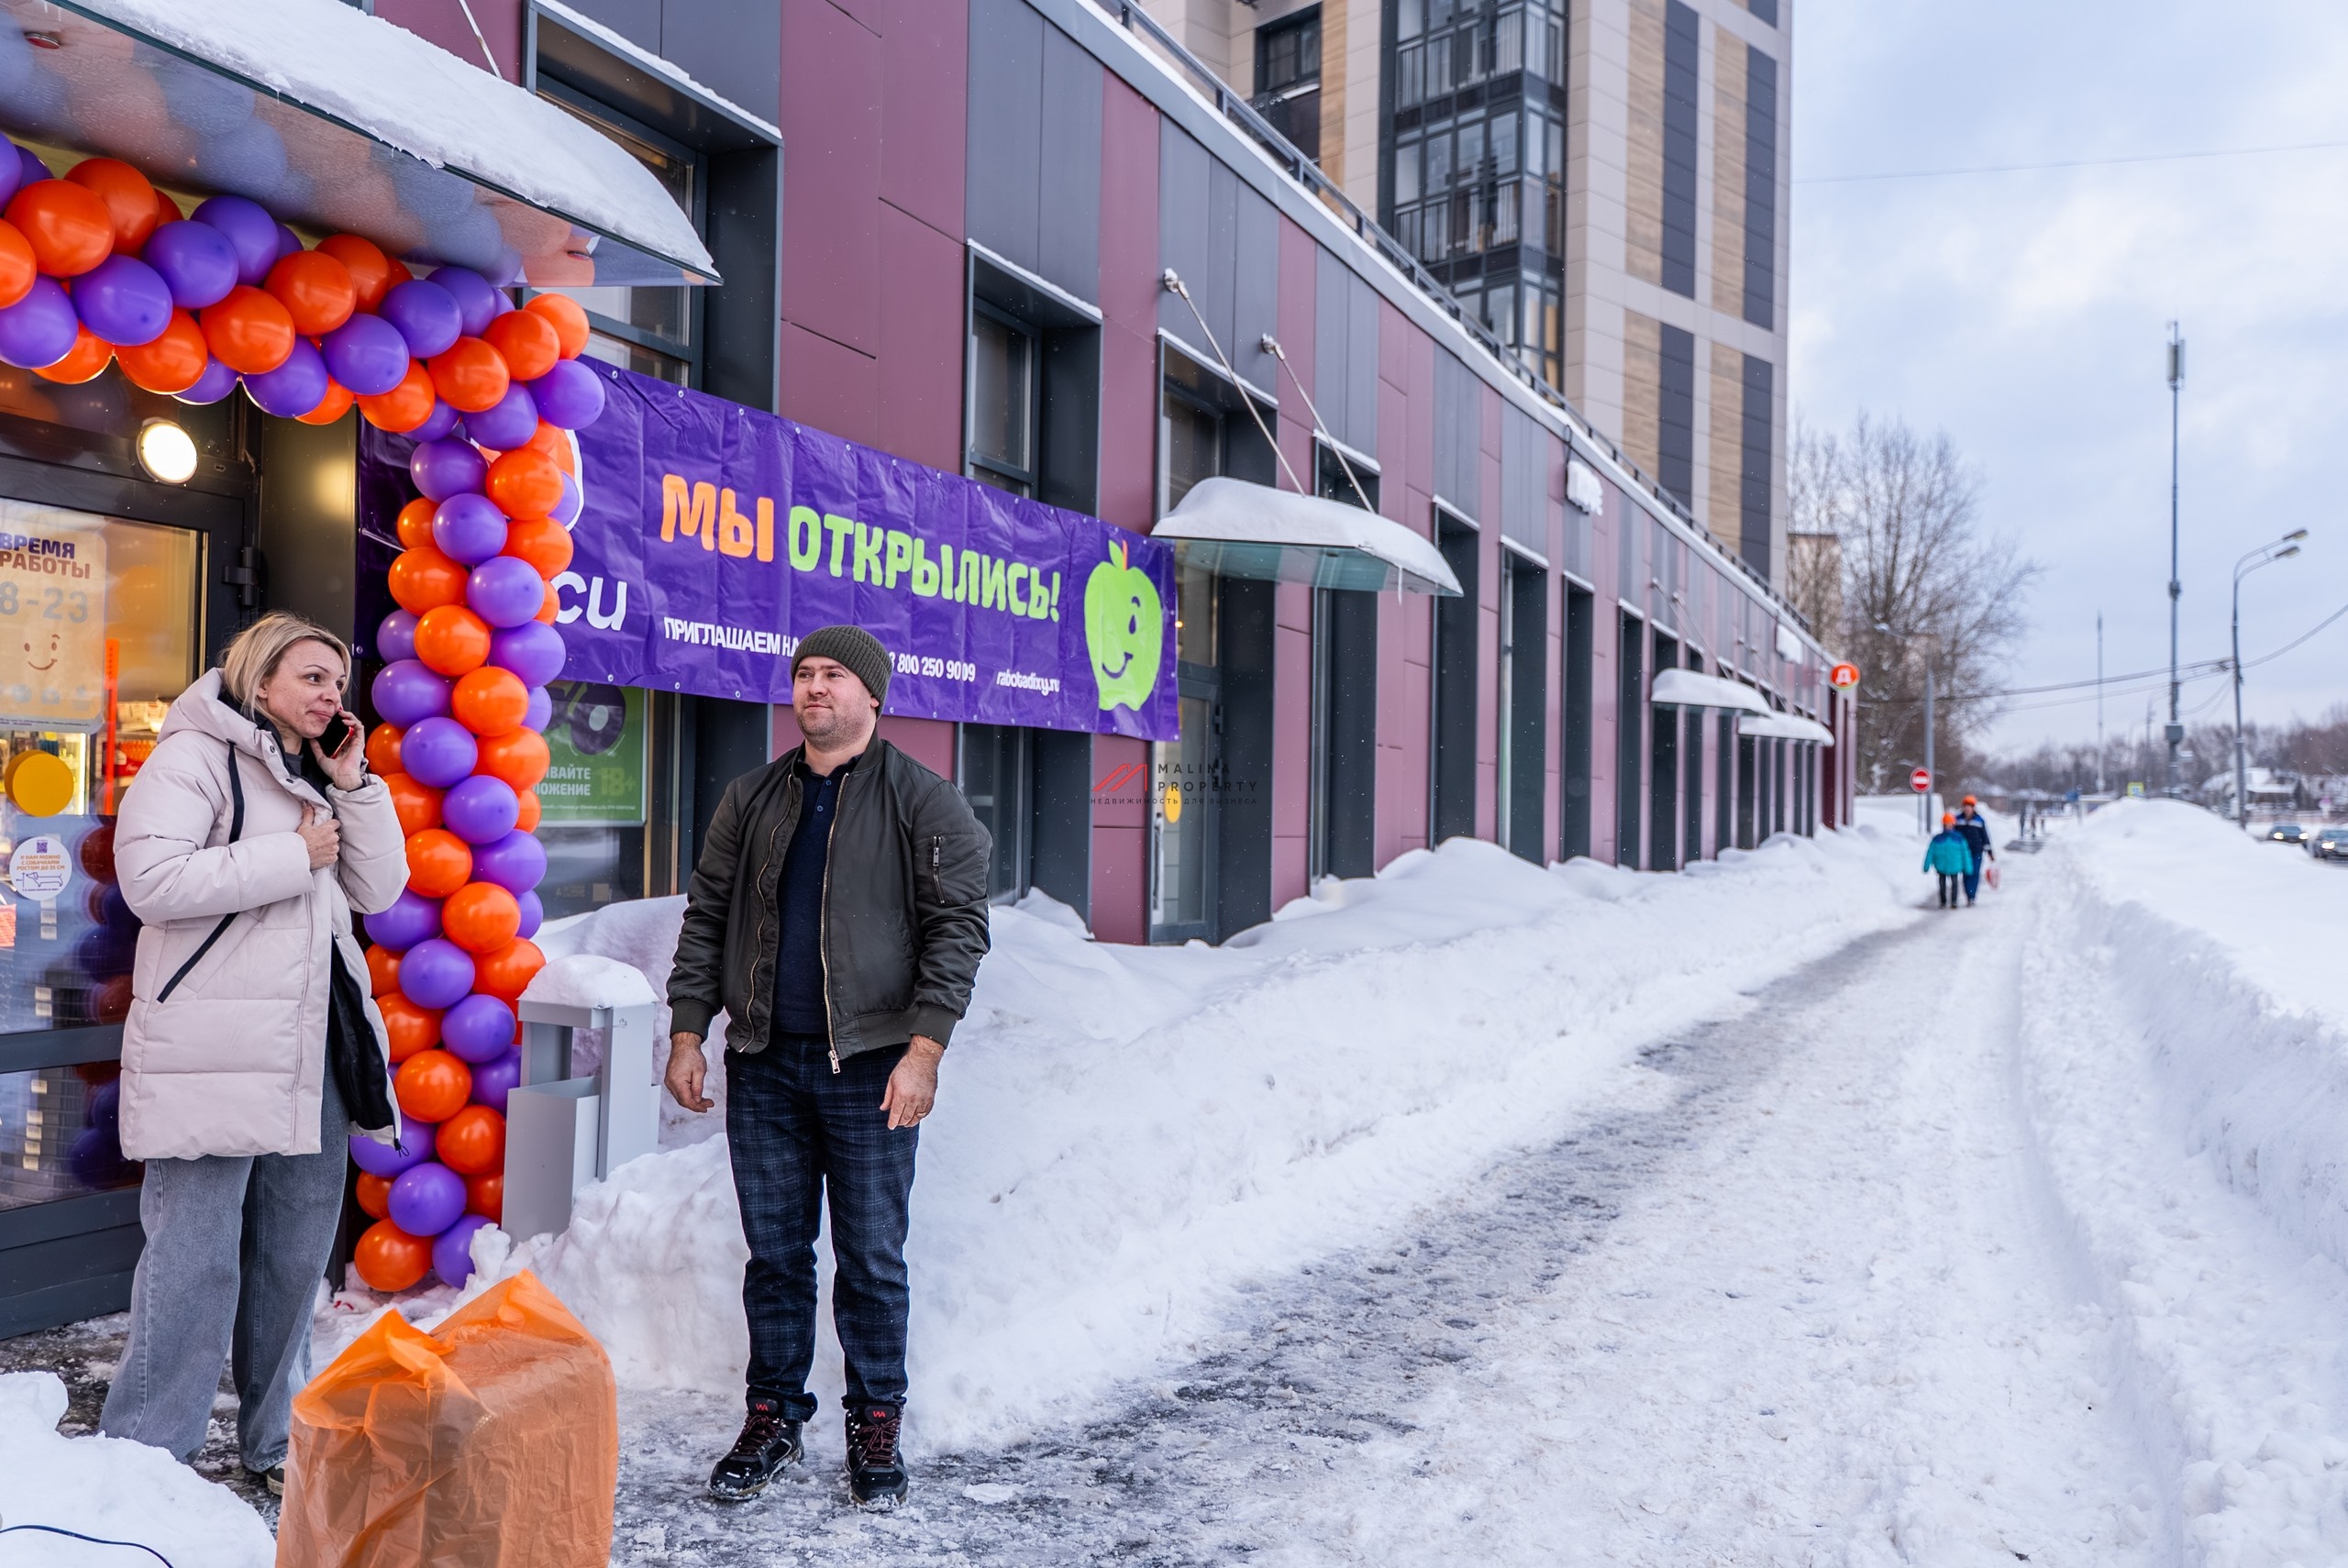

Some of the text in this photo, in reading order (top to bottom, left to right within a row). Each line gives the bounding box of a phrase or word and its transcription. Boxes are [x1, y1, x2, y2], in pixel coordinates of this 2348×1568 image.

[0, 533, 75, 559] ВРЕМЯ
[660, 474, 1061, 623] МЫ ОТКРЫЛИСЬ!
[0, 550, 90, 580] РАБОТЫ
[663, 616, 781, 654] ПРИГЛАШАЕМ
[897, 652, 920, 675] 800
[922, 656, 945, 679] 250
[946, 660, 977, 682] 9009
[996, 669, 1060, 697] rabotadixy.ru
[599, 767, 637, 797] 18+
